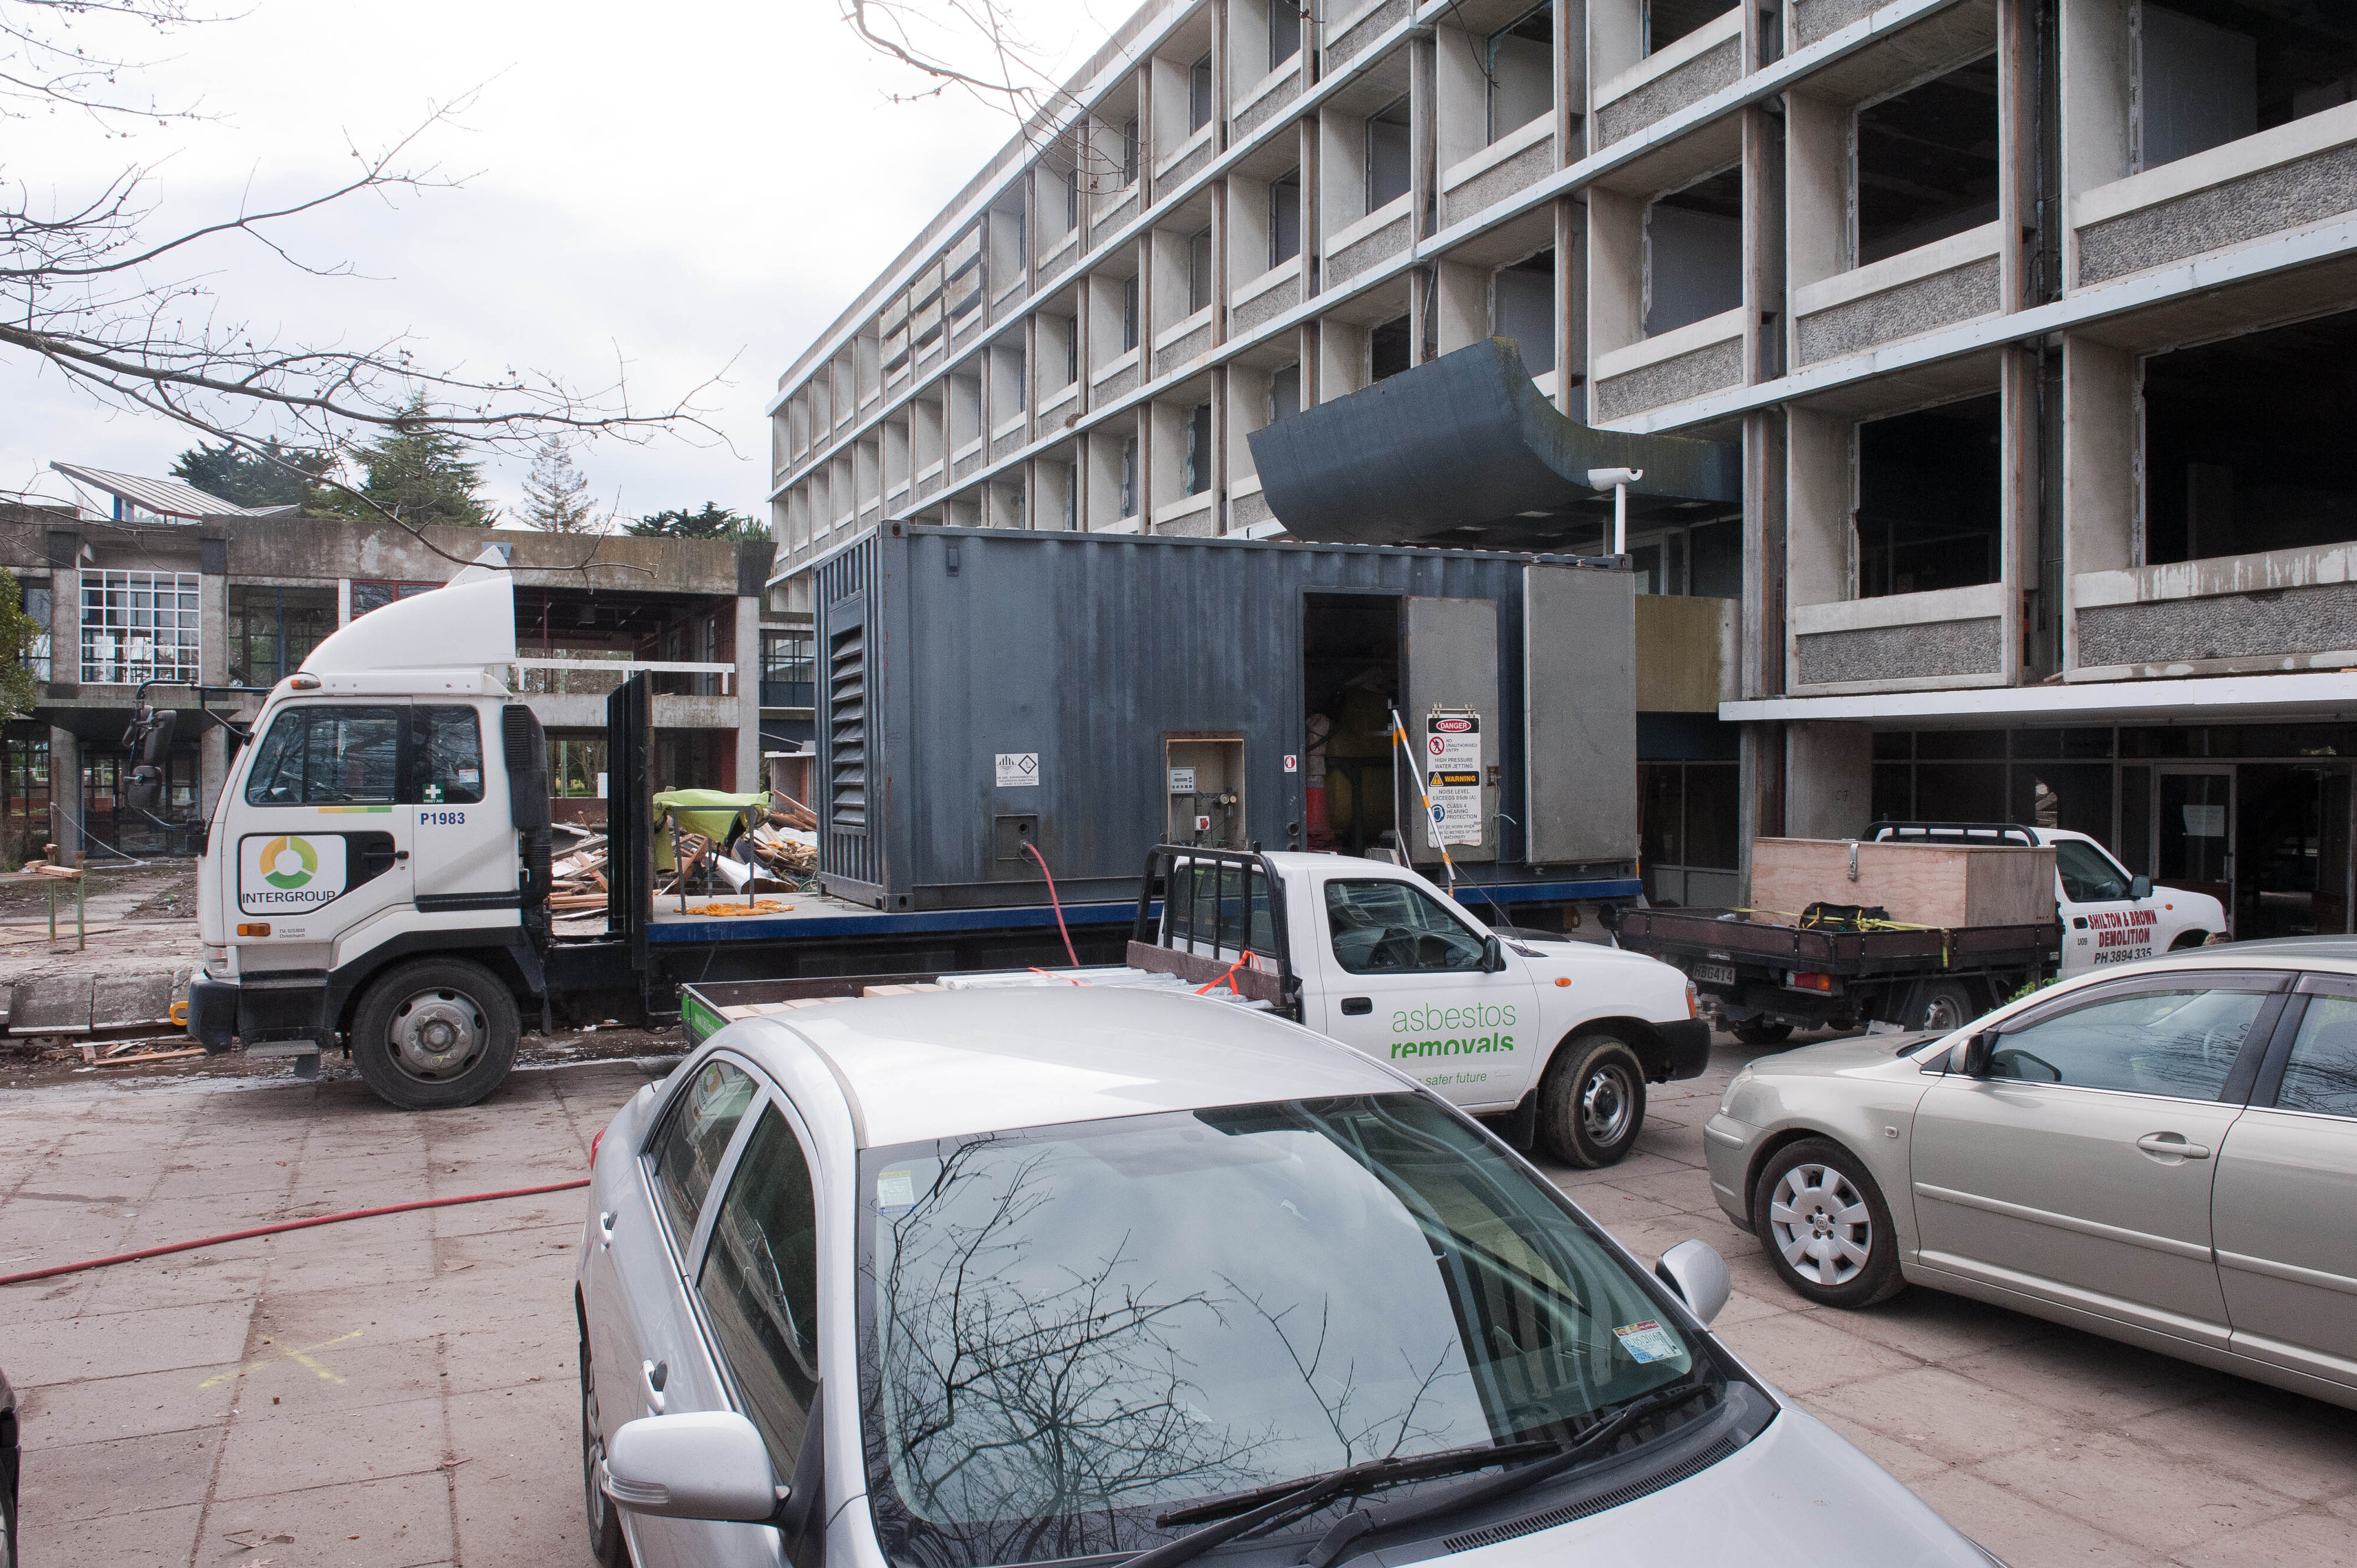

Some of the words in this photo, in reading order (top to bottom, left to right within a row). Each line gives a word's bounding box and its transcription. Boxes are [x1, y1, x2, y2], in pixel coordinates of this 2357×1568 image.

[420, 812, 465, 825] P1983
[242, 890, 336, 903] INTERGROUP
[2087, 912, 2122, 930] SHILTON
[2123, 912, 2129, 927] &
[2129, 909, 2157, 926] BROWN
[2077, 937, 2088, 946] U09
[2098, 927, 2150, 948] DEMOLITION
[2094, 950, 2107, 964] PH
[2109, 949, 2132, 963] 3894
[2134, 947, 2152, 959] 335
[1392, 1002, 1516, 1032] asbestos
[1390, 1032, 1514, 1059] removals
[1425, 1074, 1453, 1085] safer
[1456, 1072, 1487, 1084] future
